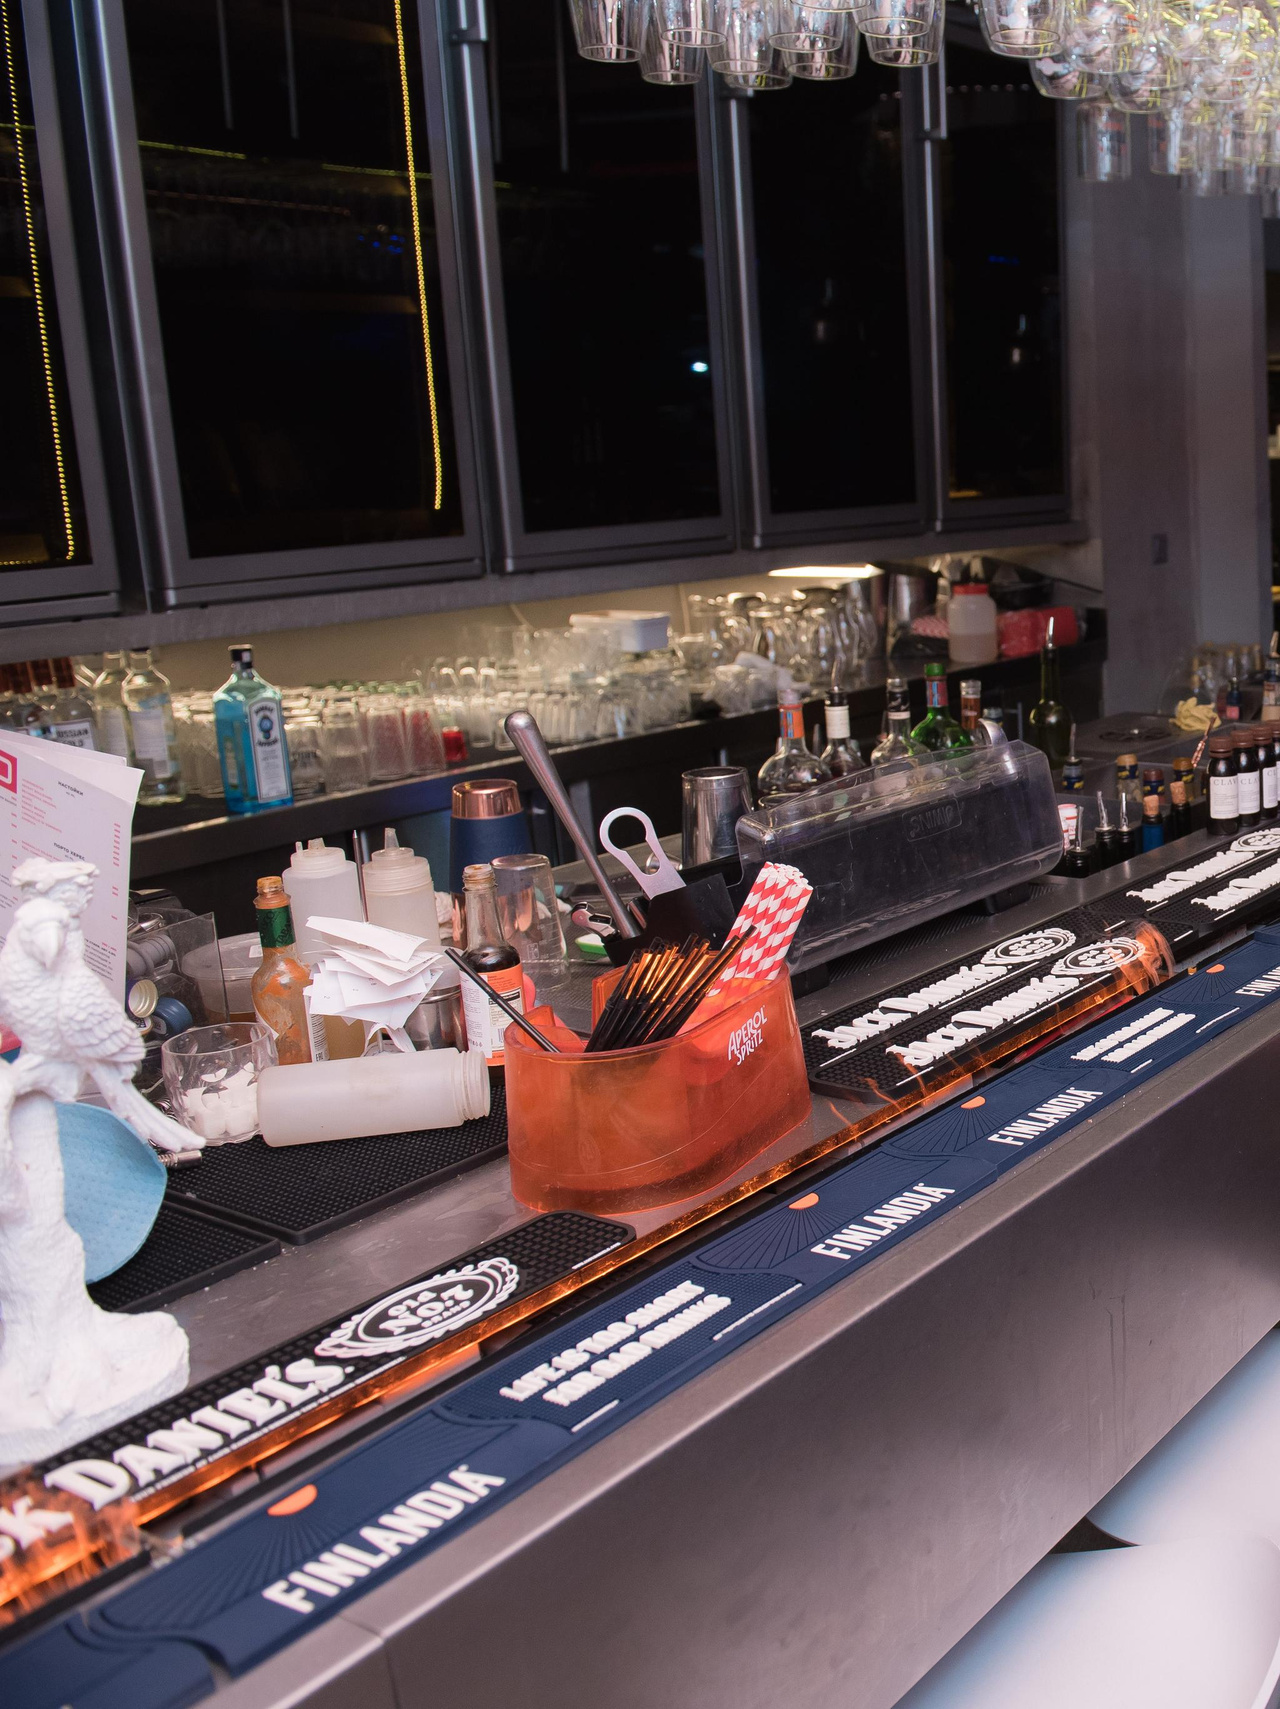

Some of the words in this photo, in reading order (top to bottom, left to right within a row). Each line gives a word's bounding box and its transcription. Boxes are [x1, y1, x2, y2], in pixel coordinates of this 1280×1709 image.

[728, 1006, 768, 1061] APEROL
[987, 1087, 1103, 1146] FINLANDIA
[810, 1183, 956, 1260] FINLANDIA
[44, 1357, 347, 1511] DANIEL'S
[262, 1465, 507, 1614] FINLANDIA
